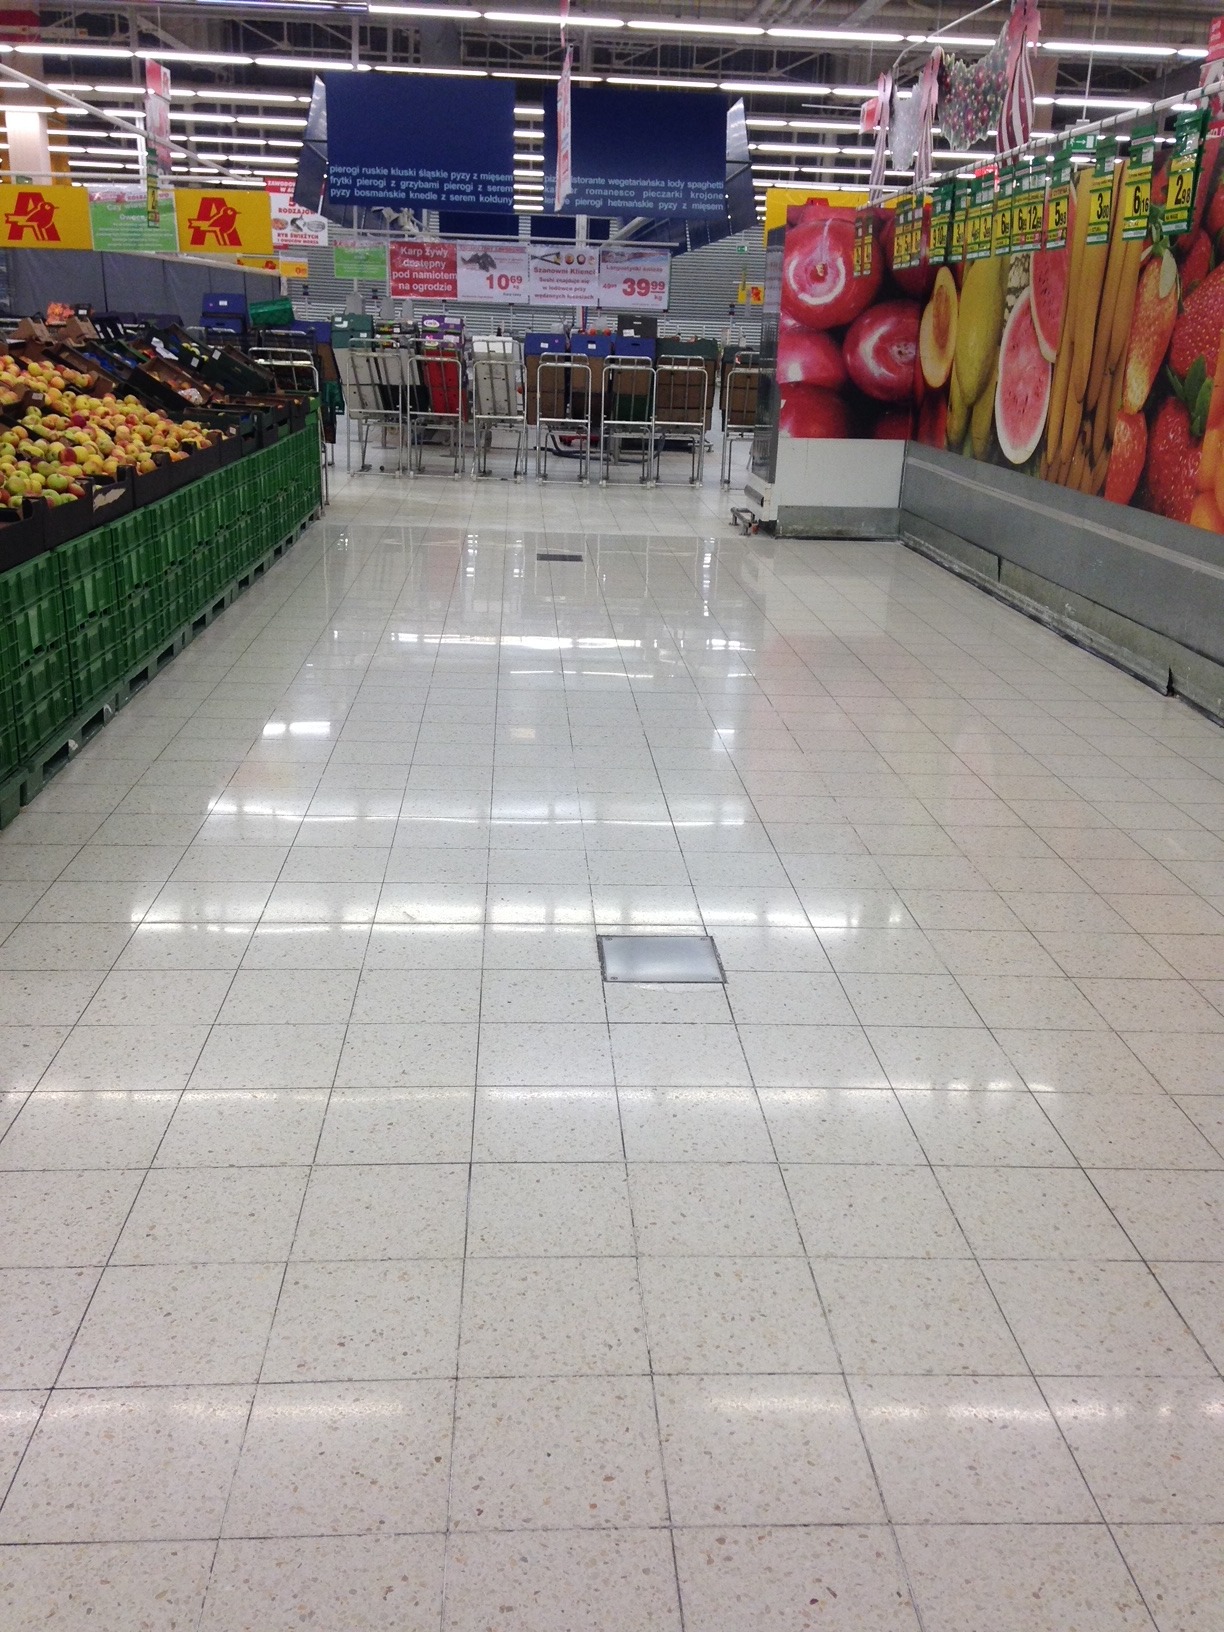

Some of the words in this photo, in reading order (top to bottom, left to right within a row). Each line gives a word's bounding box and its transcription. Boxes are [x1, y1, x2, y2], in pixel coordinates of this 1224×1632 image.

[330, 166, 360, 175] pierogi
[362, 166, 388, 176] ruskie
[390, 168, 416, 176] kluski
[418, 168, 448, 180] śląskie
[450, 172, 470, 181] pyzy
[480, 172, 514, 182] mięsem
[330, 175, 352, 186] frytki
[356, 177, 387, 188] pierogi
[400, 178, 440, 190] grzybami
[444, 180, 474, 192] pierogi
[487, 184, 514, 192] serem
[608, 176, 664, 188] wegetariańska
[668, 178, 684, 190] lody
[688, 180, 724, 192] spaghetti
[330, 188, 350, 198] pyzy
[354, 188, 406, 199] bosmańskie
[409, 190, 438, 200] knedle
[450, 194, 476, 202] serem
[586, 188, 635, 196] romanesco
[643, 188, 682, 199] pieczarki
[690, 190, 724, 200] krojone
[575, 198, 602, 208] pierogi
[608, 198, 654, 208] hetmańskie
[658, 202, 677, 210] pyzy
[692, 202, 724, 212] mięsem
[400, 246, 422, 256] Karp
[425, 246, 448, 257] żywy
[402, 259, 446, 270] dostępny
[392, 271, 410, 280] pod
[412, 270, 458, 280] namiotem
[412, 282, 452, 292] ogrodzie
